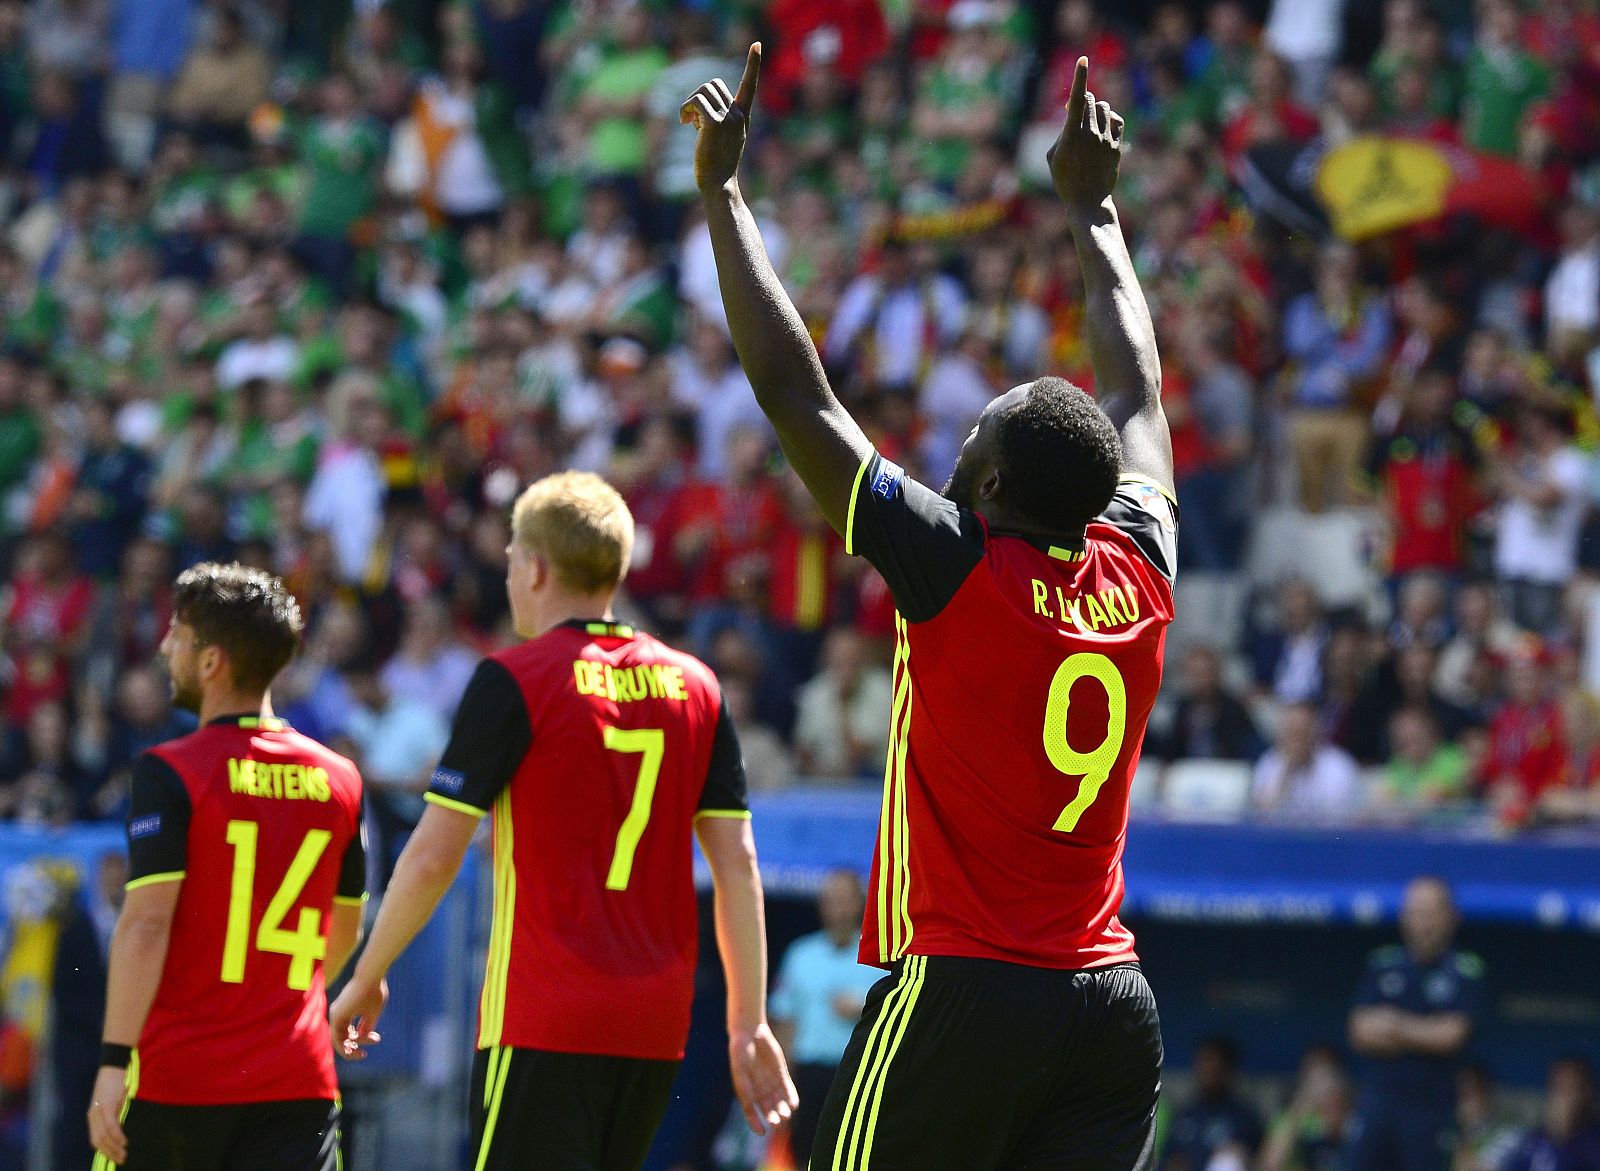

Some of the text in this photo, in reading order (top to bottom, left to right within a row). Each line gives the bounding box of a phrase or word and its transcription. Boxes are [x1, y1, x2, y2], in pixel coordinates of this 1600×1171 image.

[1031, 578, 1054, 618] R.
[574, 660, 606, 697] DE
[229, 759, 330, 802] MERTENS
[1043, 653, 1126, 833] 9
[604, 727, 664, 891] 7
[222, 822, 330, 991] 14
